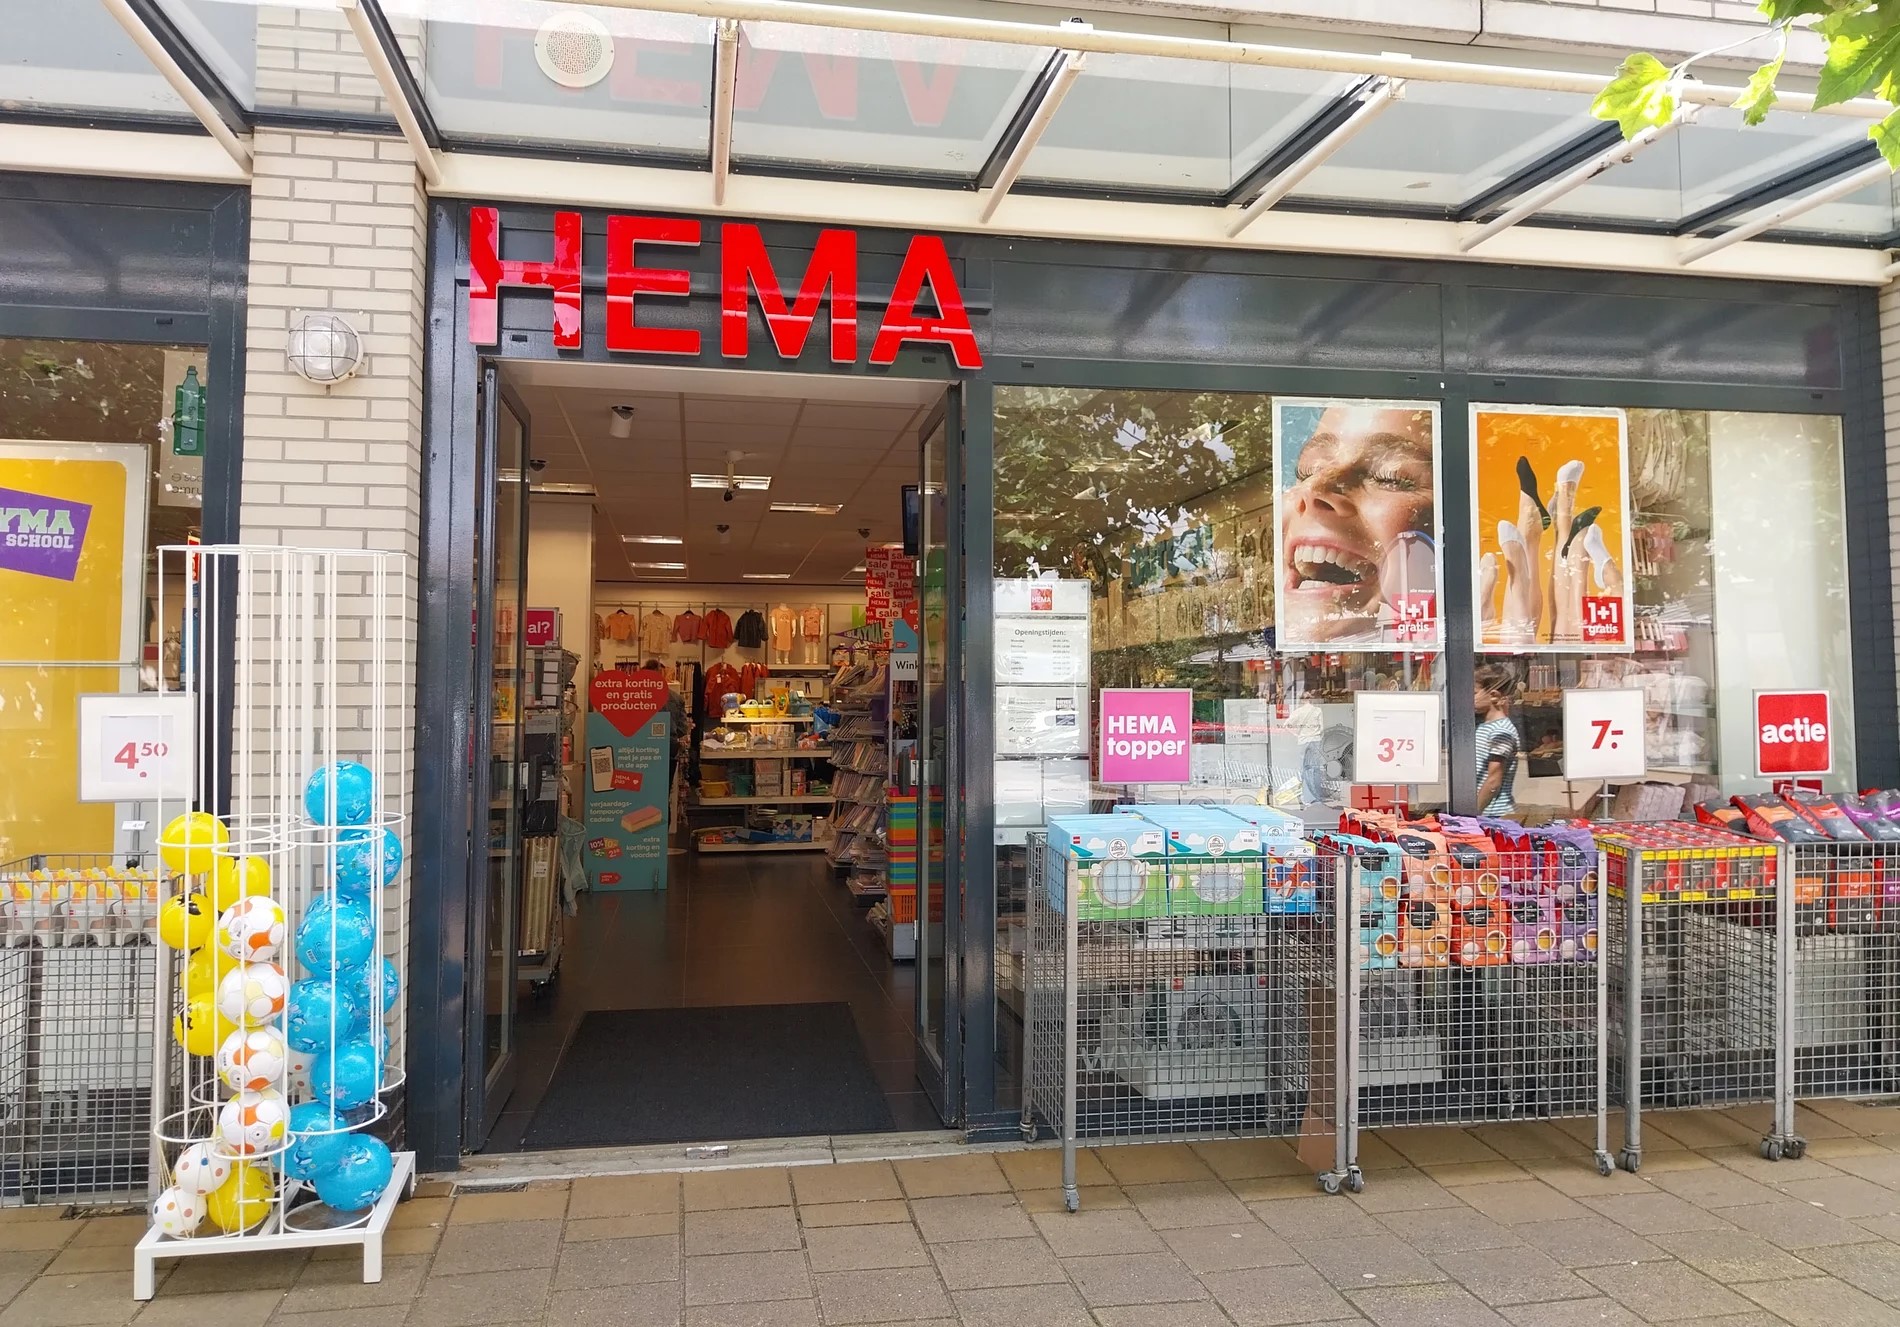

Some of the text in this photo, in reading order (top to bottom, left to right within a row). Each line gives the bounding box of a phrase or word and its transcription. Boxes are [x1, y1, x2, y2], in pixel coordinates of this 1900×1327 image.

[469, 206, 983, 370] HEMA
[5, 533, 75, 549] SCHOOL
[868, 560, 888, 569] sale
[875, 570, 896, 579] sale
[888, 580, 909, 588] sale
[870, 589, 891, 598] sale
[878, 609, 899, 618] sale
[1397, 599, 1429, 621] 1+1
[1588, 602, 1618, 623] 1+1
[527, 621, 551, 634] al?
[1014, 628, 1067, 639] Openingstijden:
[1397, 621, 1430, 635] gratis
[1588, 622, 1619, 637] gratis
[595, 678, 664, 689] extra korting
[622, 690, 653, 701] gratis
[601, 701, 657, 712] producten
[1108, 715, 1177, 734] HEMA
[1761, 717, 1827, 744] actie
[1107, 736, 1186, 760] topper
